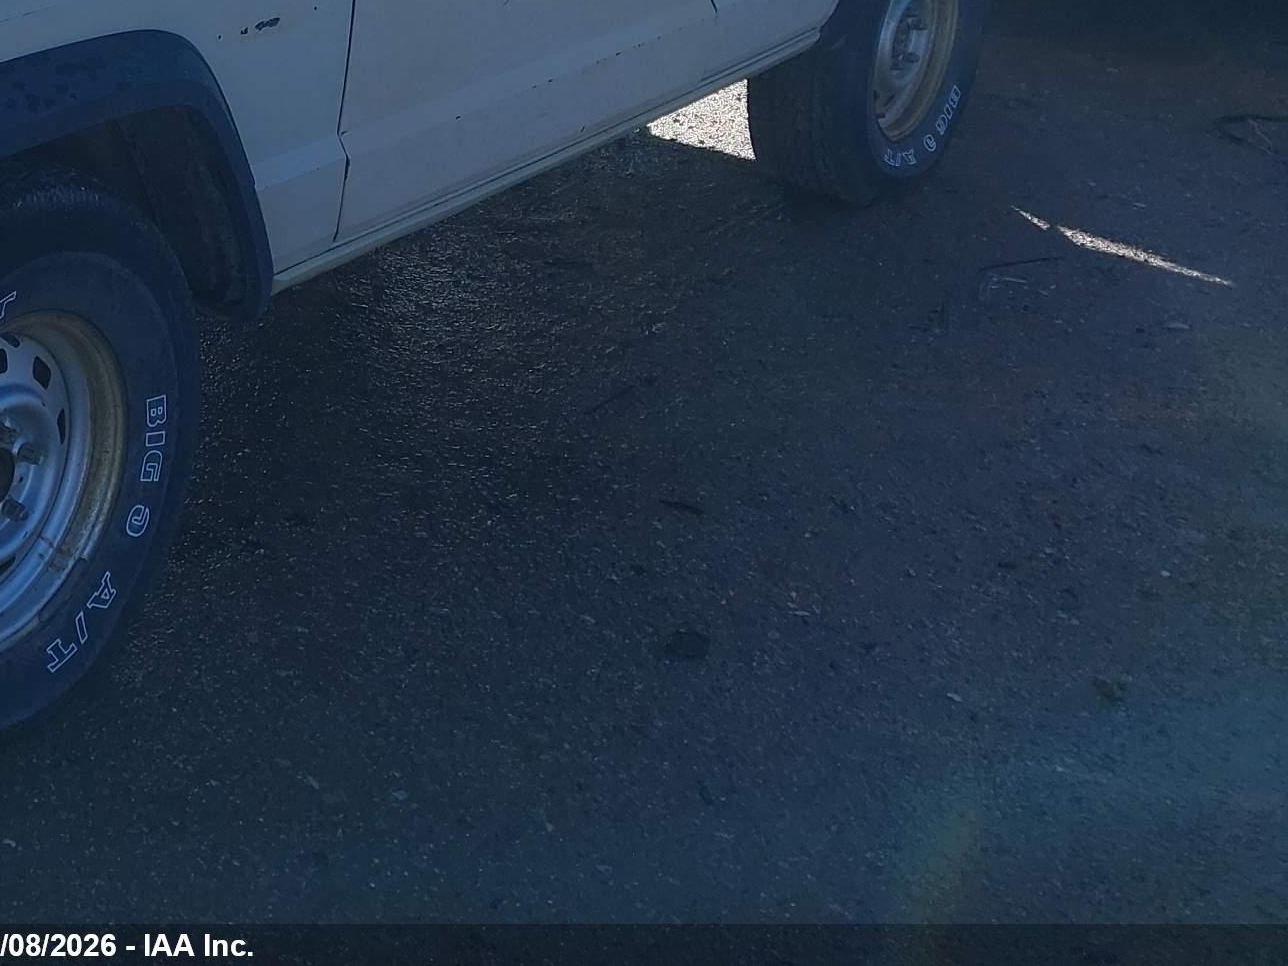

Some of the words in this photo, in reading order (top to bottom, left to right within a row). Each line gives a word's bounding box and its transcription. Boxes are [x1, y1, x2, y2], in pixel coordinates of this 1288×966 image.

[935, 85, 961, 136] BIG
[139, 394, 168, 483] BIG
[45, 571, 117, 674] A/T
